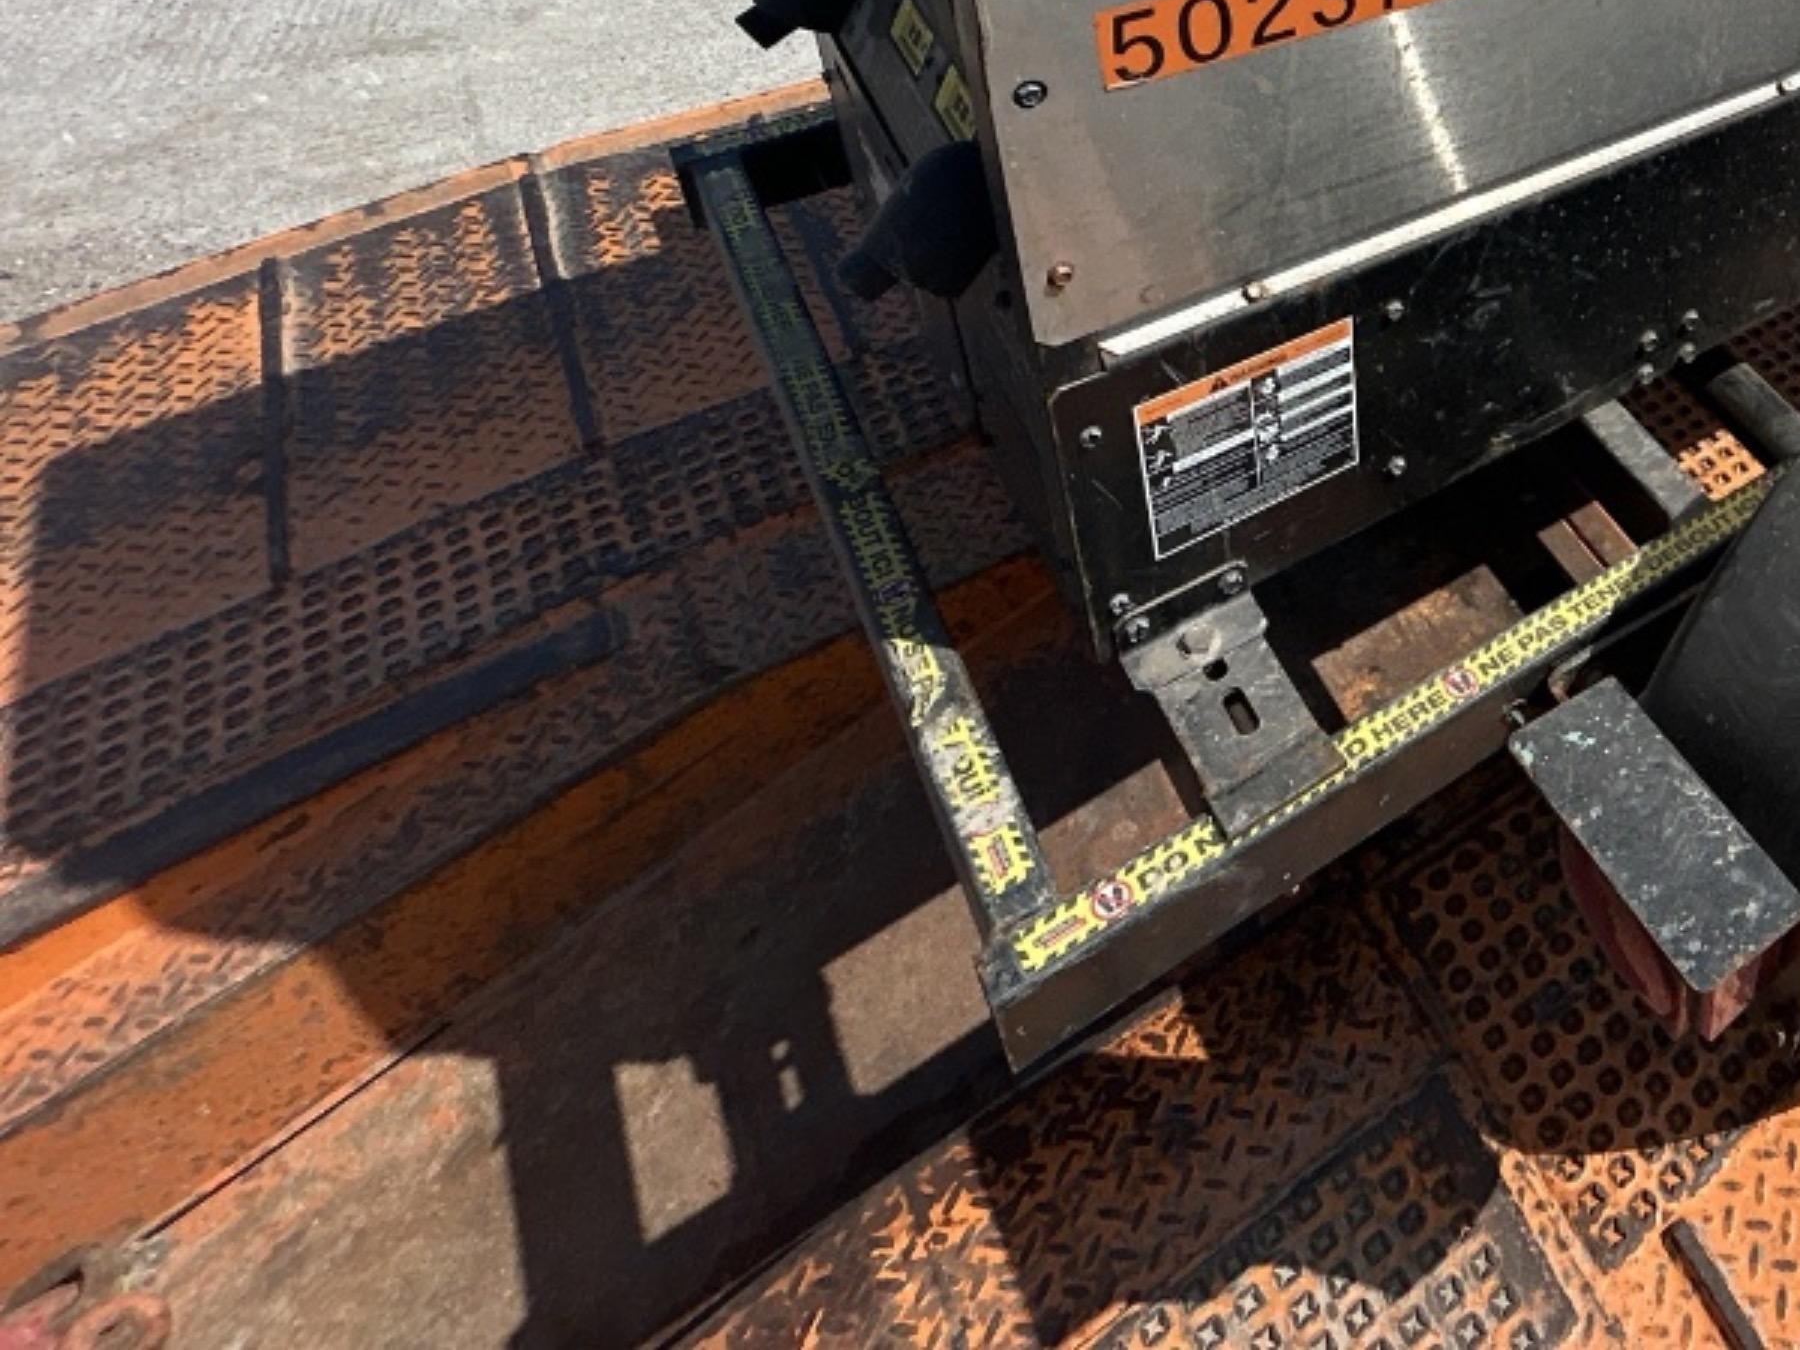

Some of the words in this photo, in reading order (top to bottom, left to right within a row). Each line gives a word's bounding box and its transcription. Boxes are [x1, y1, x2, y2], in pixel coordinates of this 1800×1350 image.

[1477, 645, 1520, 677] NE
[1516, 611, 1568, 653] PAS
[1370, 688, 1448, 742] HERE
